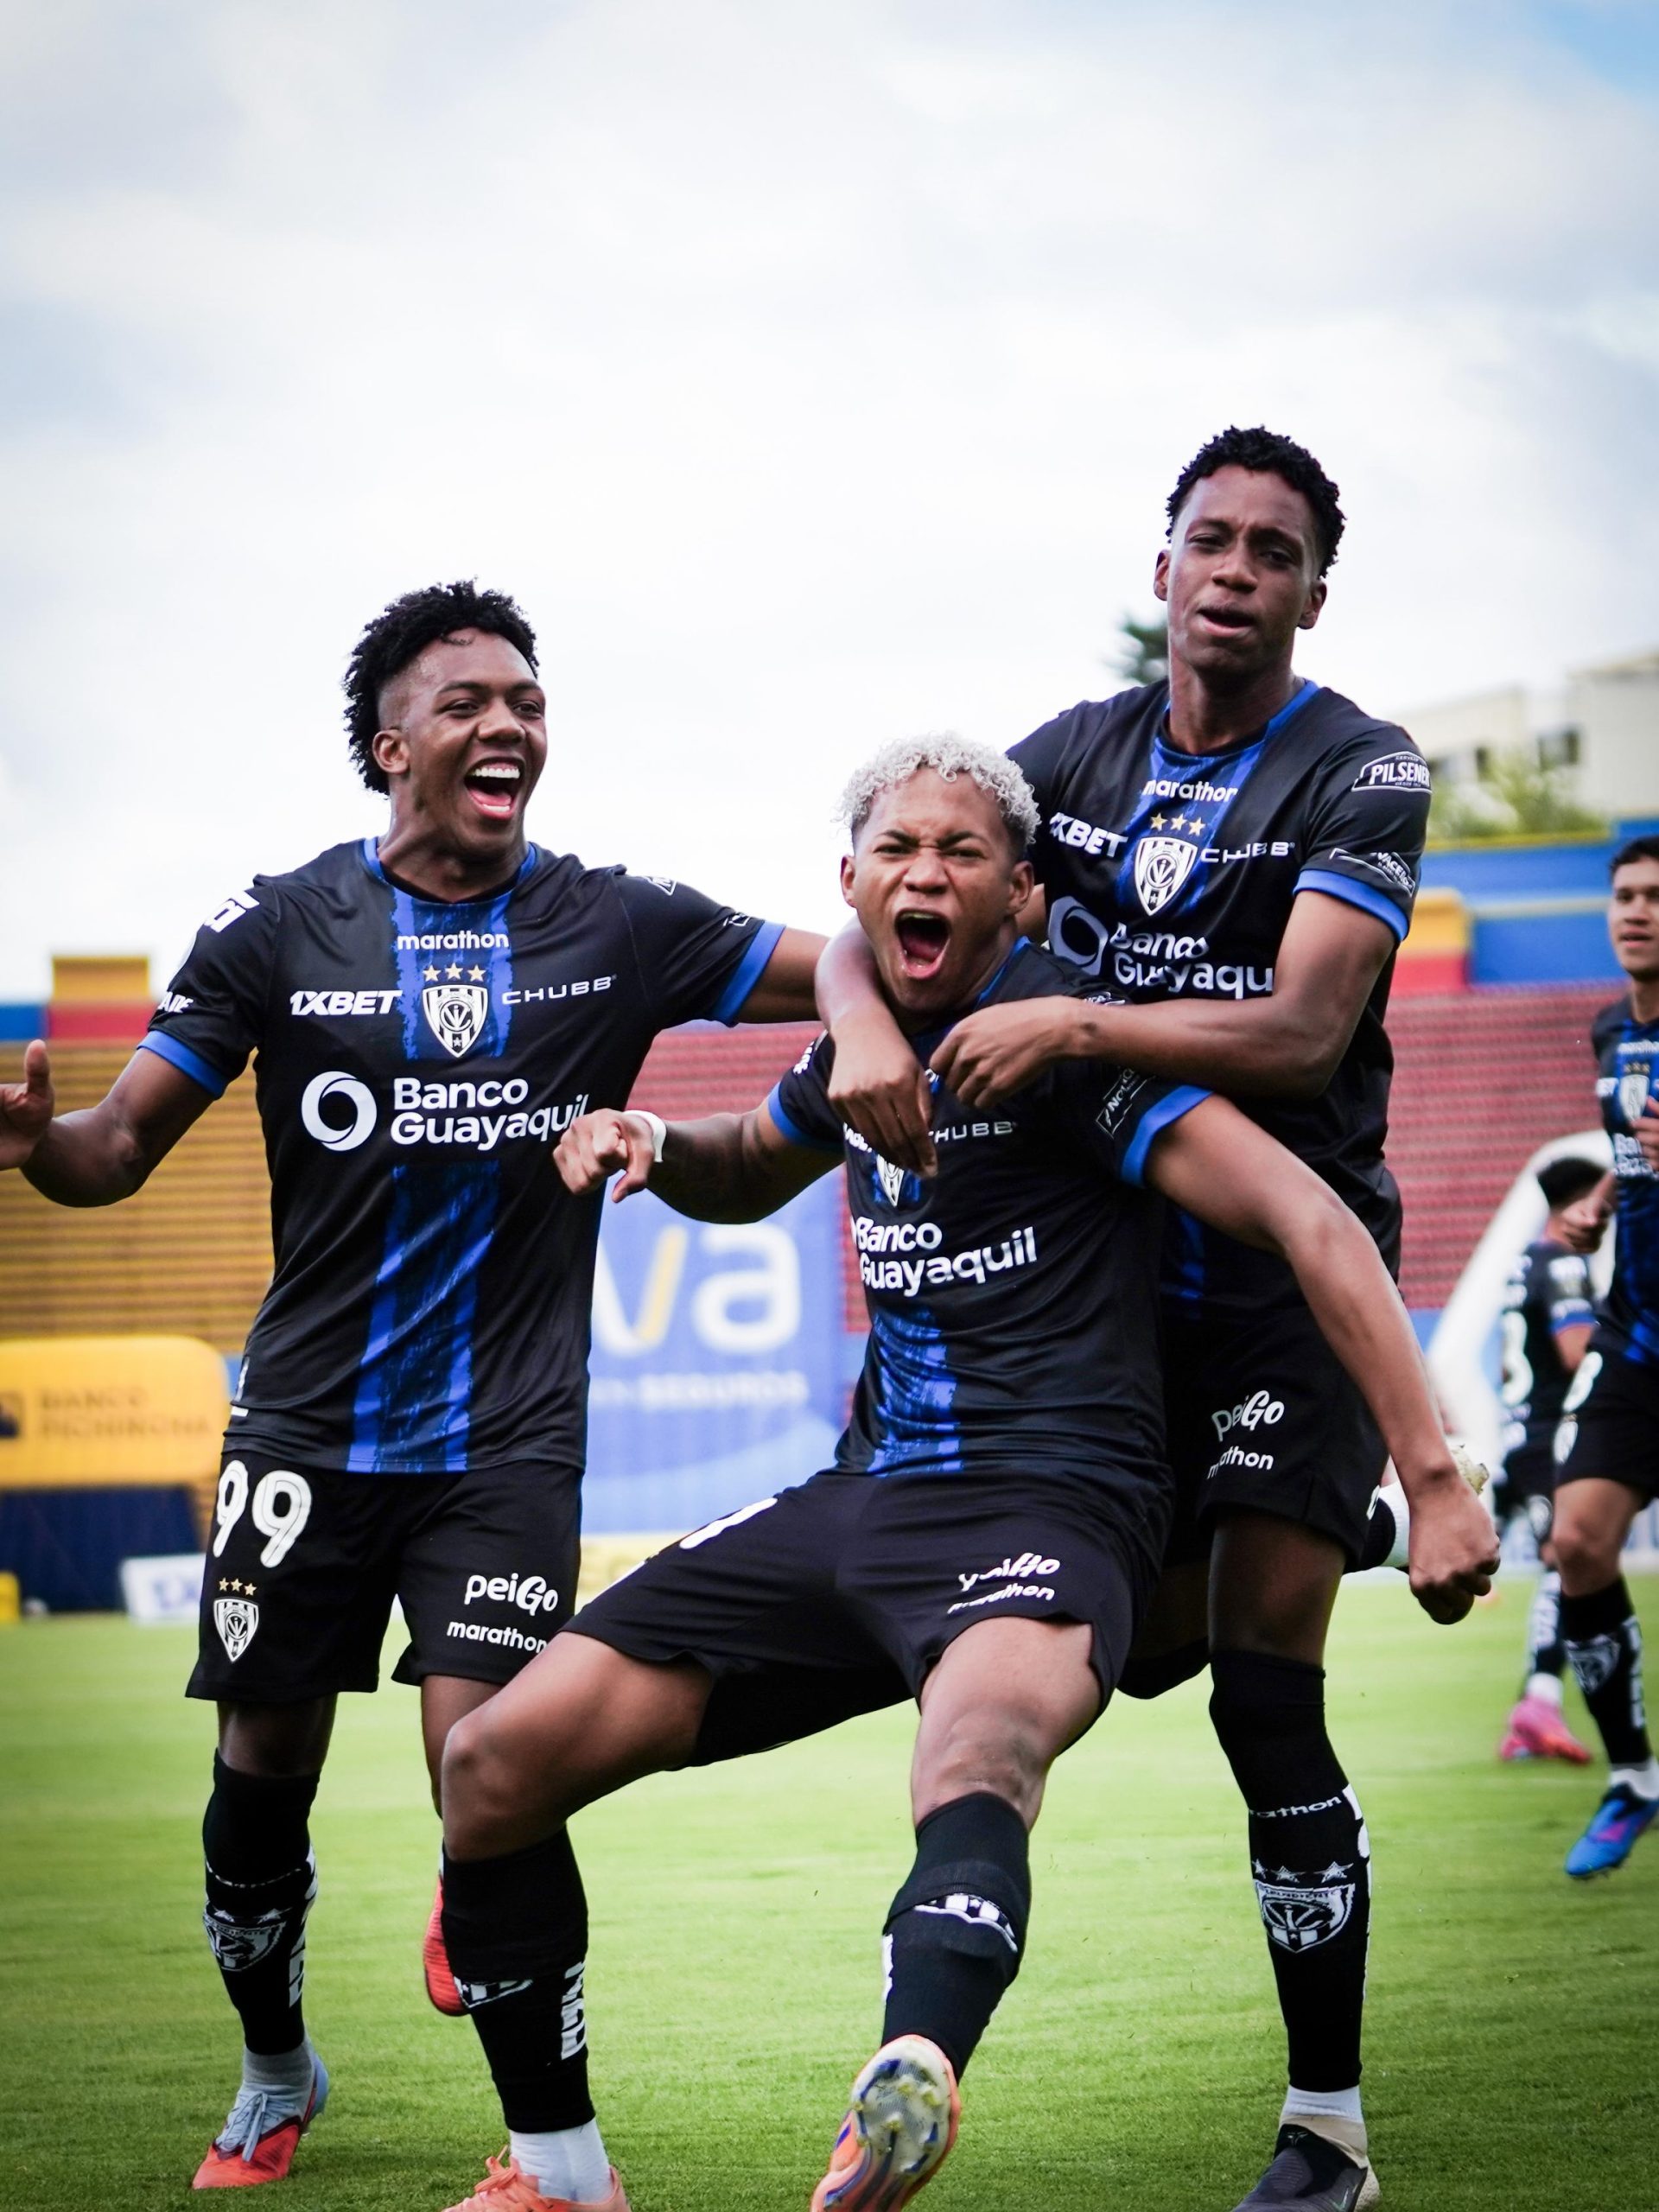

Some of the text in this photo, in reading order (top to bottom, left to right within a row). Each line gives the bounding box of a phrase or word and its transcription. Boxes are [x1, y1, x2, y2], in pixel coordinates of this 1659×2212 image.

[397, 931, 509, 950] marathon
[501, 976, 613, 1006] CHUBB
[1114, 954, 1274, 1000] Guayaqu
[289, 990, 403, 1016] 1XBET
[394, 1077, 529, 1110] Banco
[391, 1094, 589, 1151] Guayaquil
[928, 1122, 1014, 1143] HUBB
[855, 1216, 943, 1252] Banco
[860, 1226, 1037, 1297] Guayaquil
[1206, 1446, 1274, 1479] mathon
[213, 1459, 313, 1568] 99
[463, 1573, 558, 1617] peiGo
[446, 1621, 548, 1654] marathon
